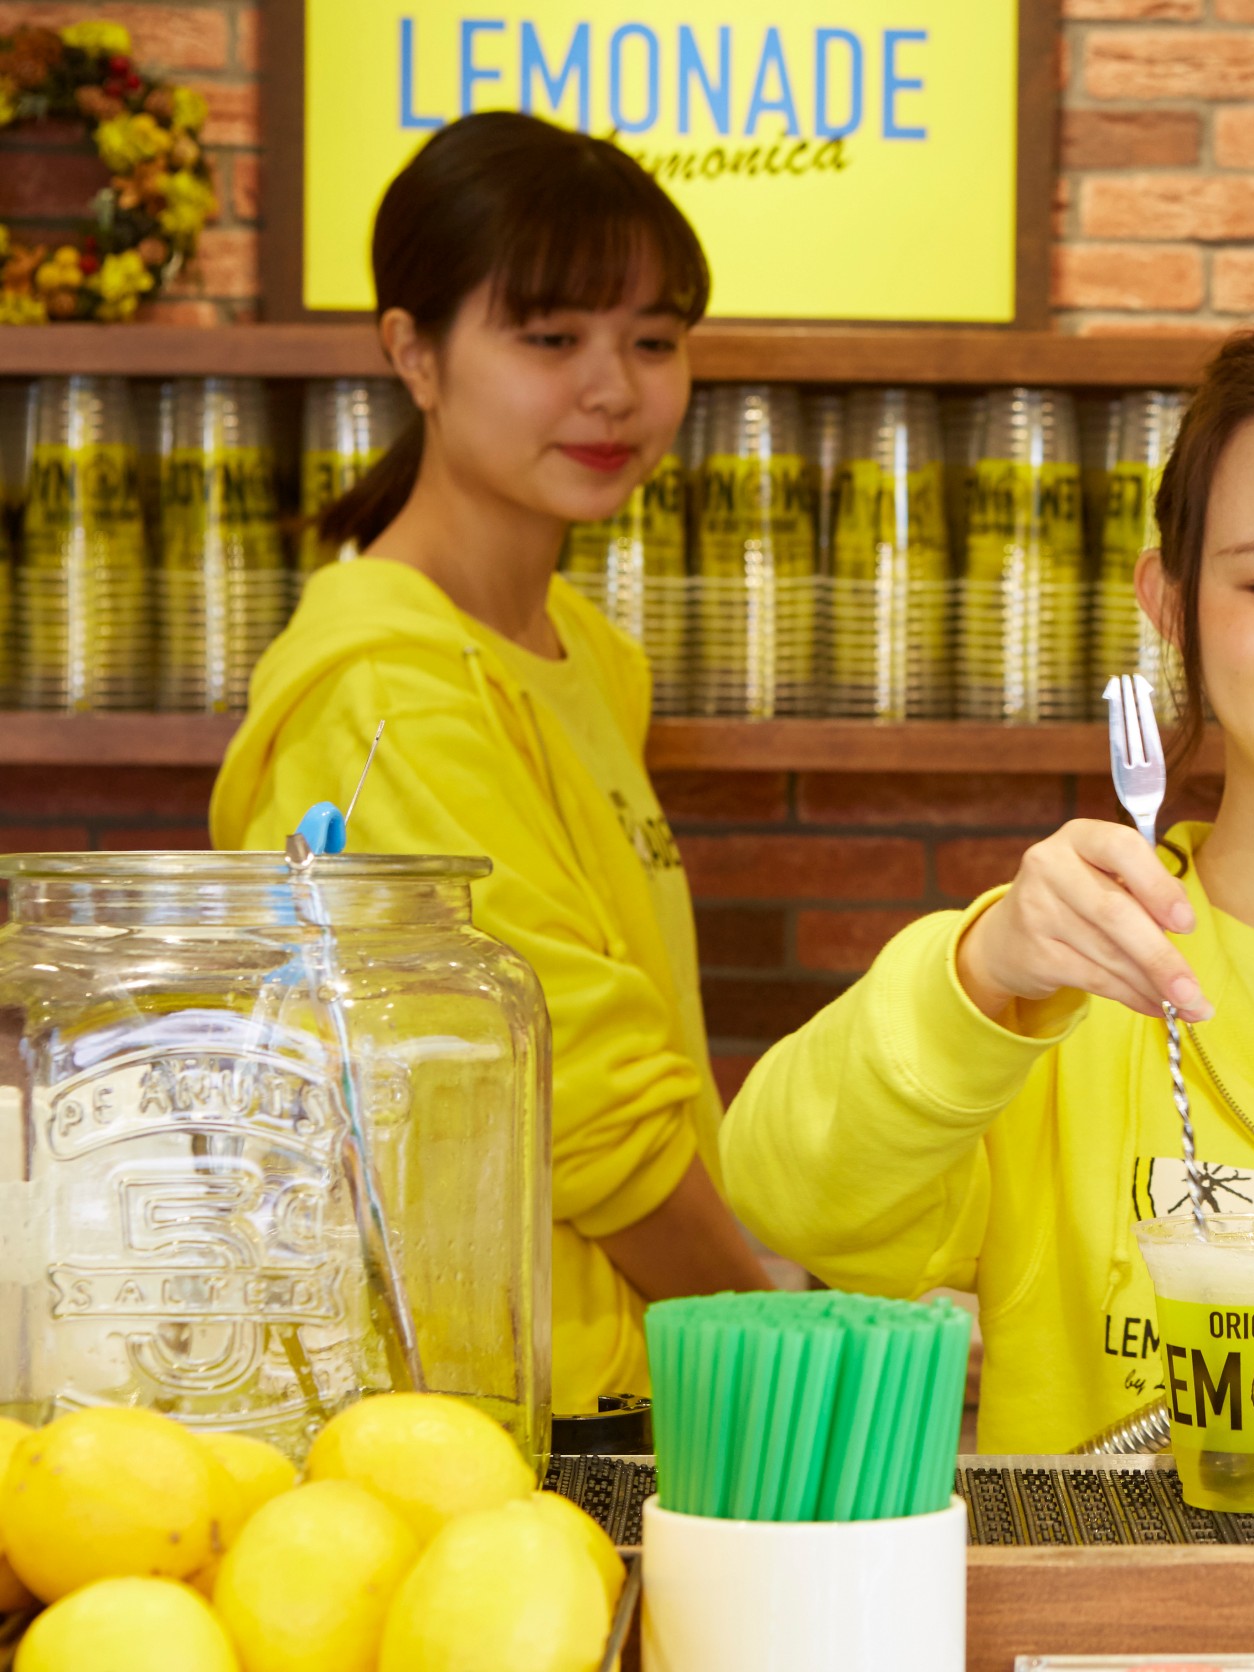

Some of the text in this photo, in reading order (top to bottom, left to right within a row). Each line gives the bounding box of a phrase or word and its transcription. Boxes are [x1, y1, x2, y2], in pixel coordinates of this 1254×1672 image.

[399, 18, 928, 140] LEMONADE
[56, 1068, 329, 1138] PEANUTS
[72, 1279, 323, 1310] SALTED
[1125, 1369, 1146, 1396] by
